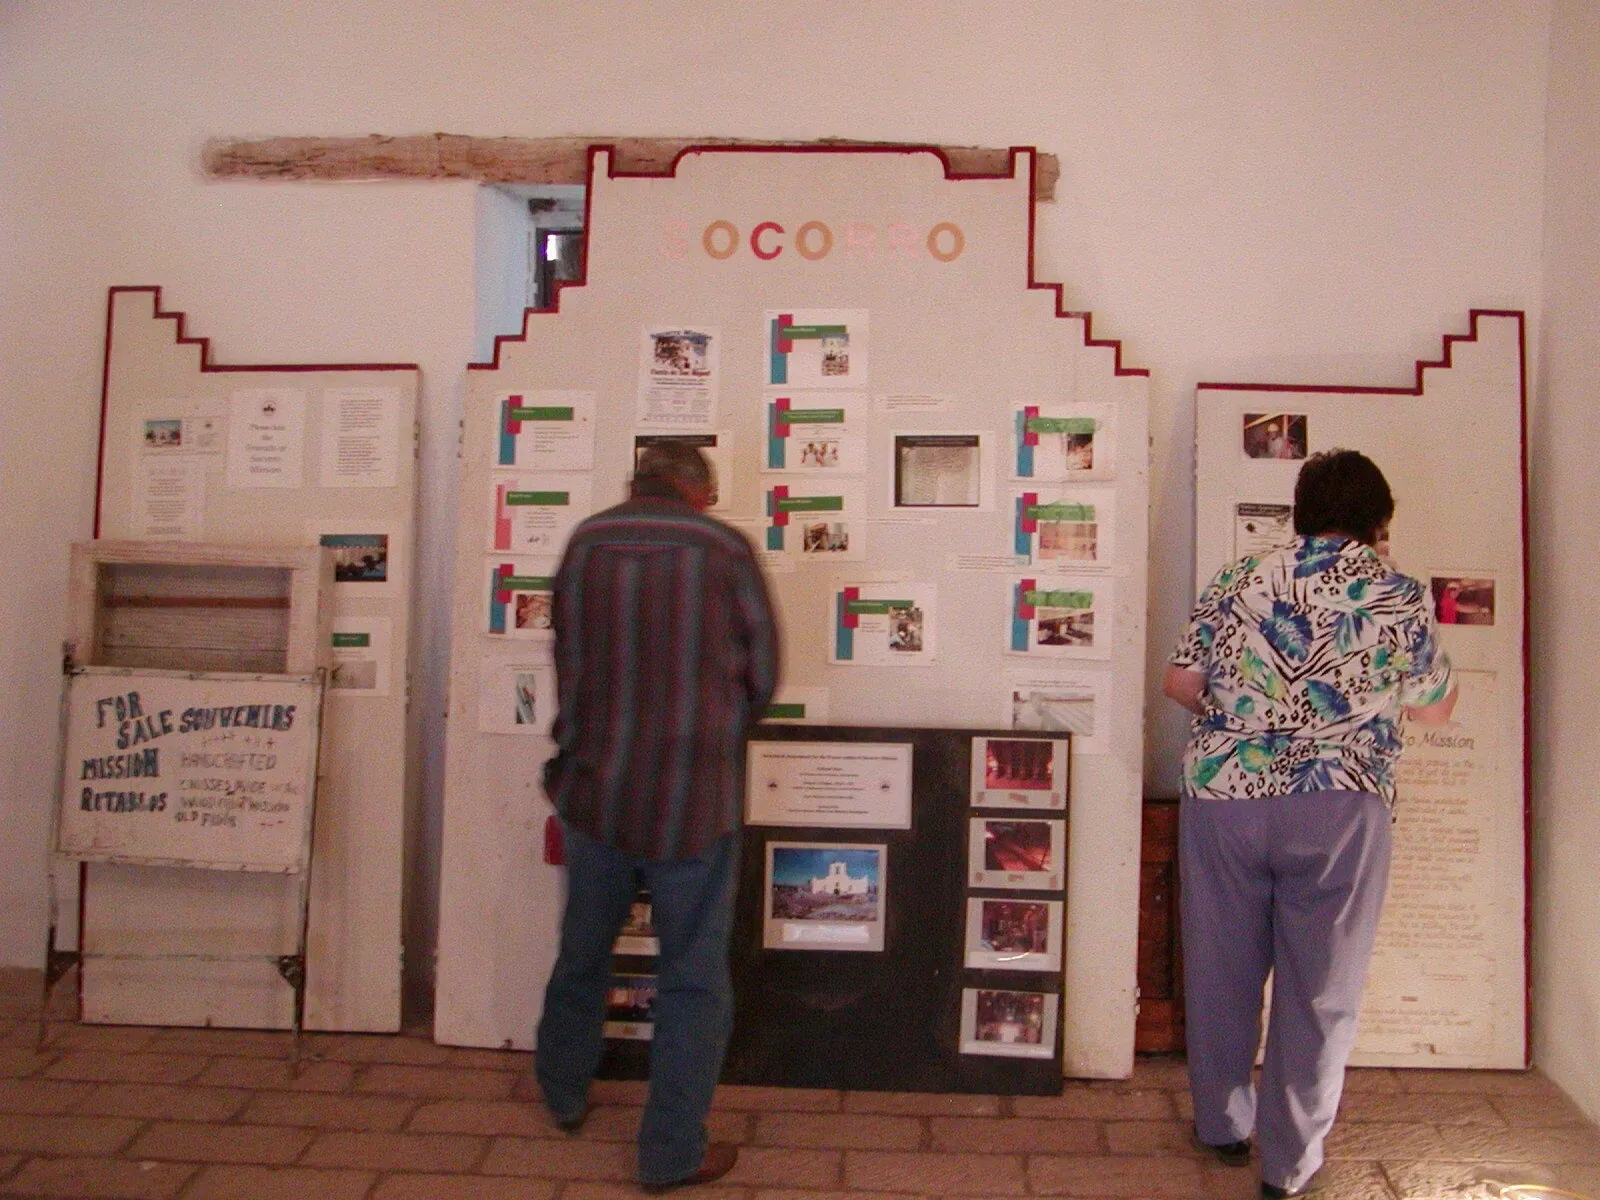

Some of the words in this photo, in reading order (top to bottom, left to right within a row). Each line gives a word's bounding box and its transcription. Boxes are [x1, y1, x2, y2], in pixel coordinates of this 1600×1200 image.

[660, 218, 966, 263] SOCORRO
[95, 691, 143, 729] FOR
[116, 709, 173, 750] SALE
[1419, 731, 1475, 750] Mission
[80, 747, 160, 781] MISSION
